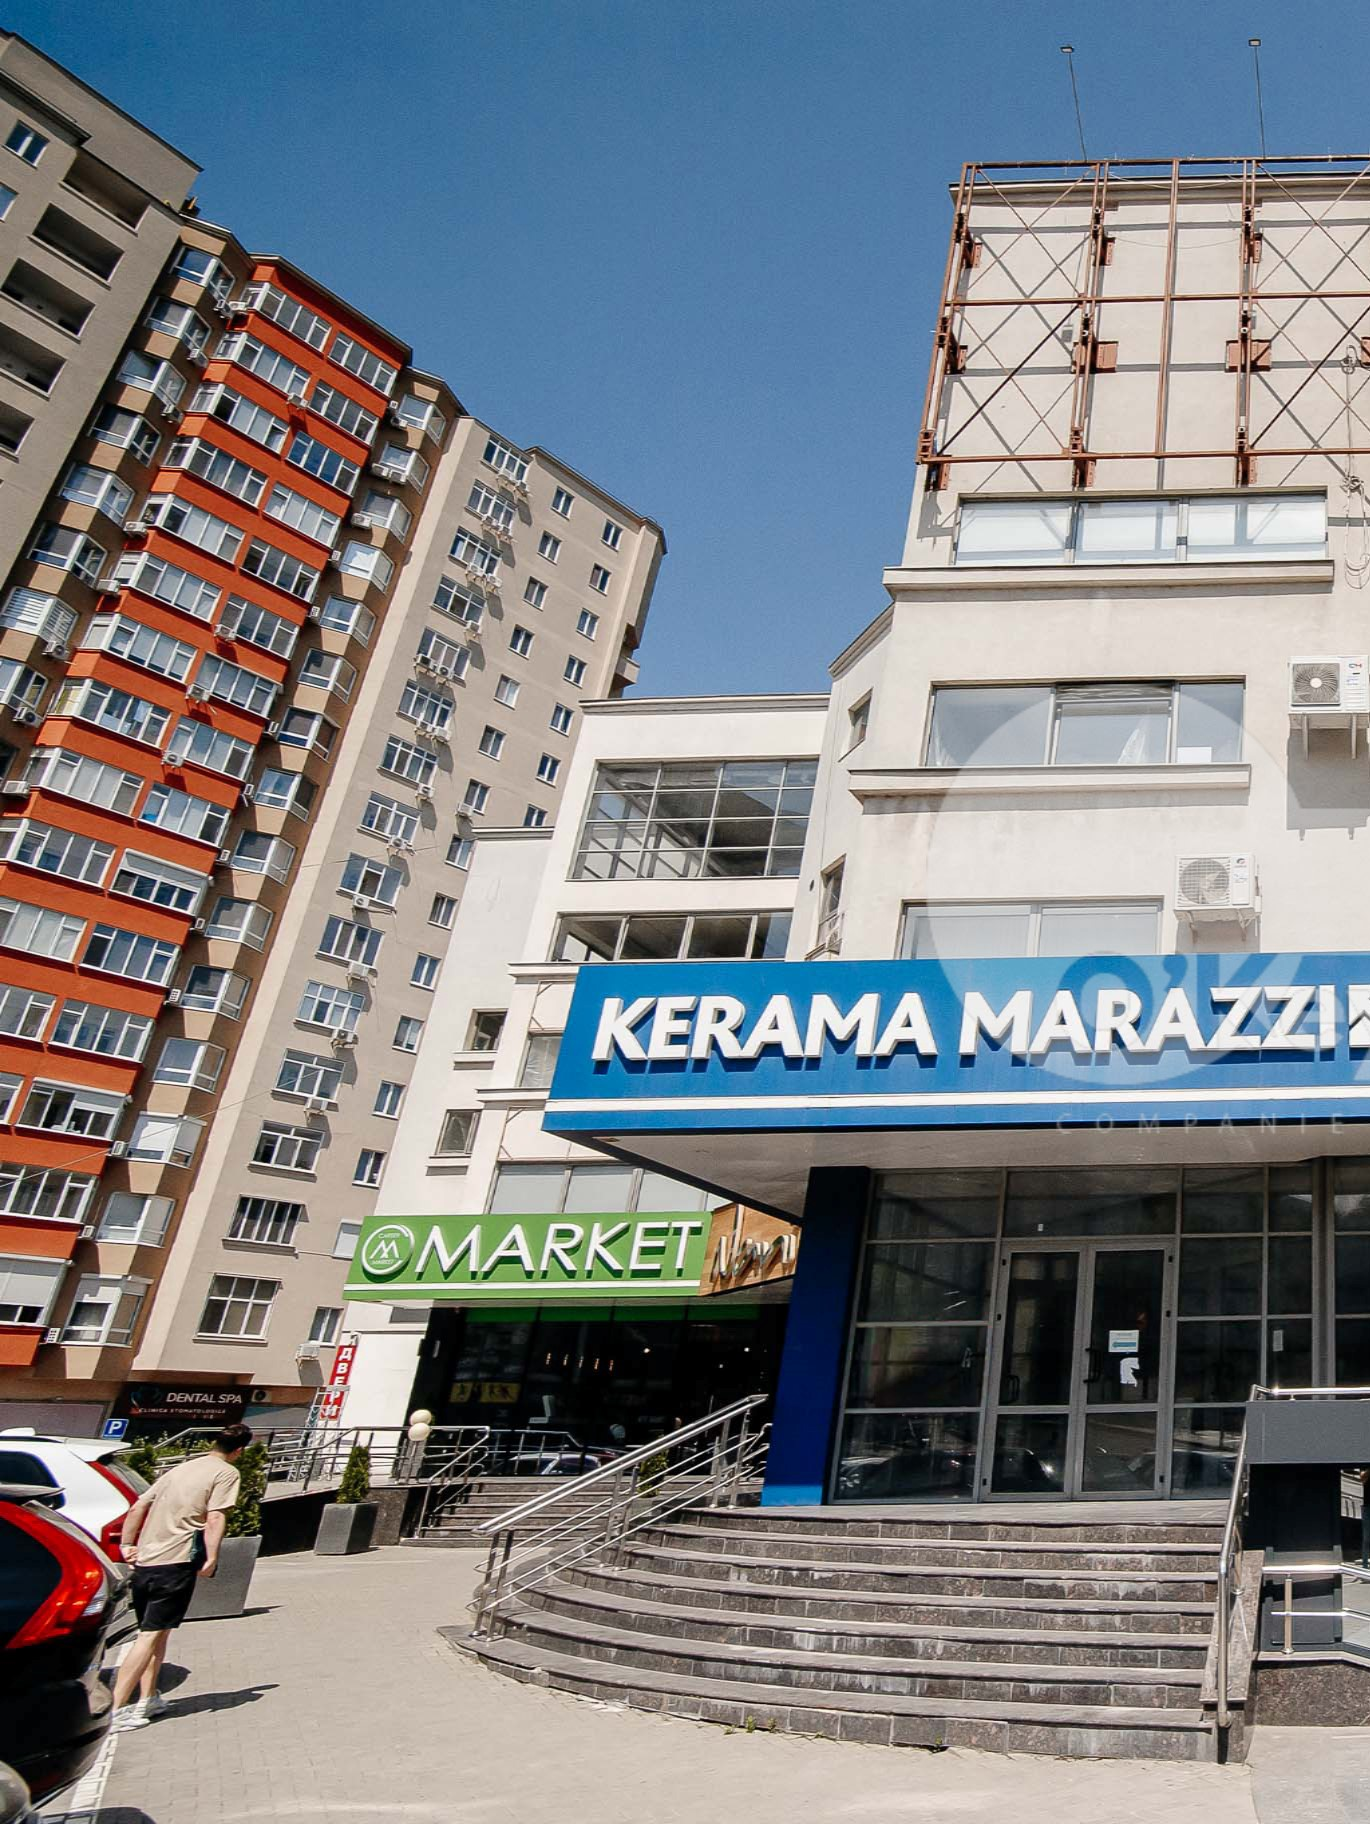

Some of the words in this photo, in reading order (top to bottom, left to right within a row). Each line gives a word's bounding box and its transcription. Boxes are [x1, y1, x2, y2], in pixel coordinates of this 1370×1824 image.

[592, 991, 939, 1062] KERAMA
[959, 984, 1337, 1057] MARAZZI
[415, 1221, 704, 1276] MARKET
[166, 1392, 216, 1403] DENTAL
[217, 1394, 242, 1404] SPA
[324, 1347, 353, 1417] ДВЕРИ
[108, 1420, 123, 1434] P
